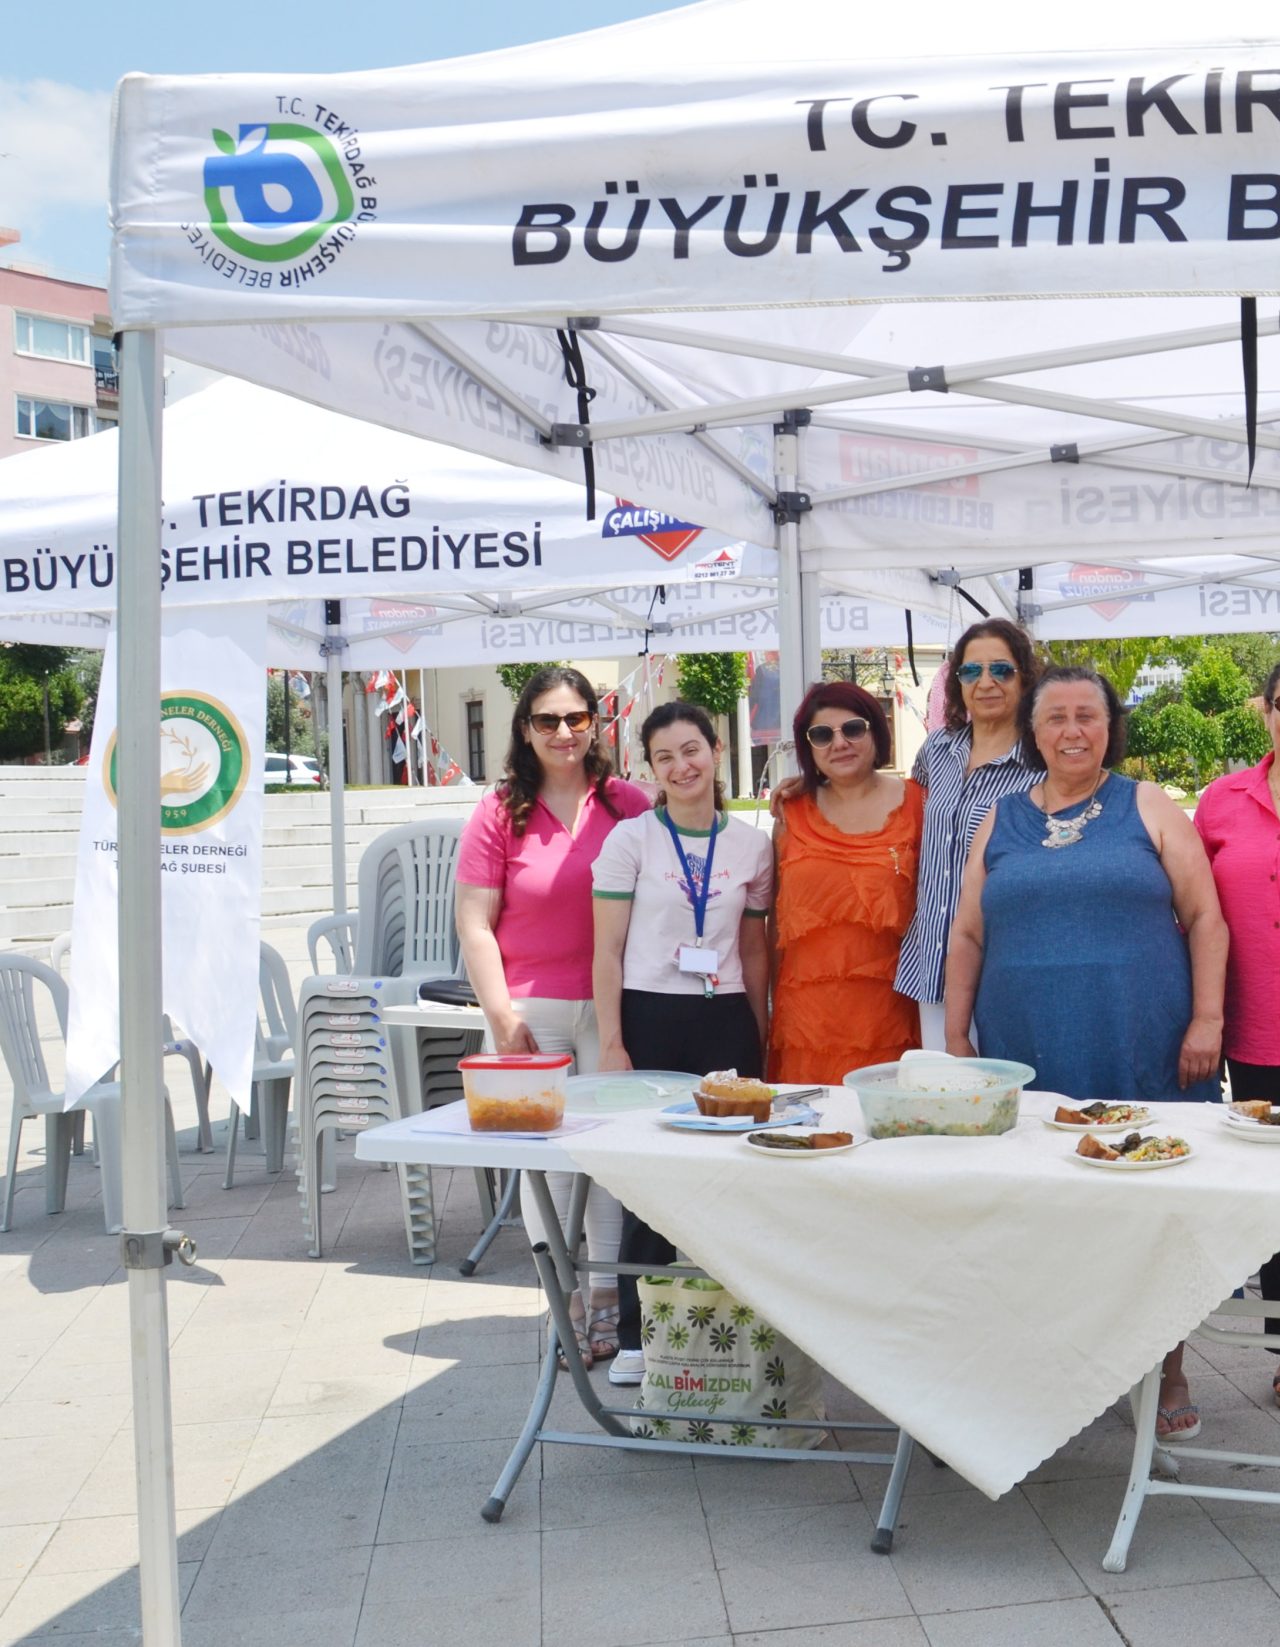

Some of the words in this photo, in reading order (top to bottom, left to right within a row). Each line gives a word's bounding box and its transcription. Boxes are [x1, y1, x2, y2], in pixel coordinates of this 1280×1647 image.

[275, 96, 306, 117] T.C.
[313, 104, 377, 190] TEKİRDAĞ
[512, 157, 1188, 273] BÜYÜKŞEHİR
[192, 479, 411, 528] TEKİRDAĞ
[287, 521, 542, 575] BELEDİYESİ
[197, 710, 233, 752] DERNEĞİ
[164, 809, 188, 819] 959
[93, 840, 118, 851] TÜR
[193, 844, 247, 857] DERNEĞİ
[181, 862, 226, 874] ŞUBESİ
[647, 1369, 752, 1392] KALBİMİZDEN
[667, 1391, 727, 1414] Geleceğe
